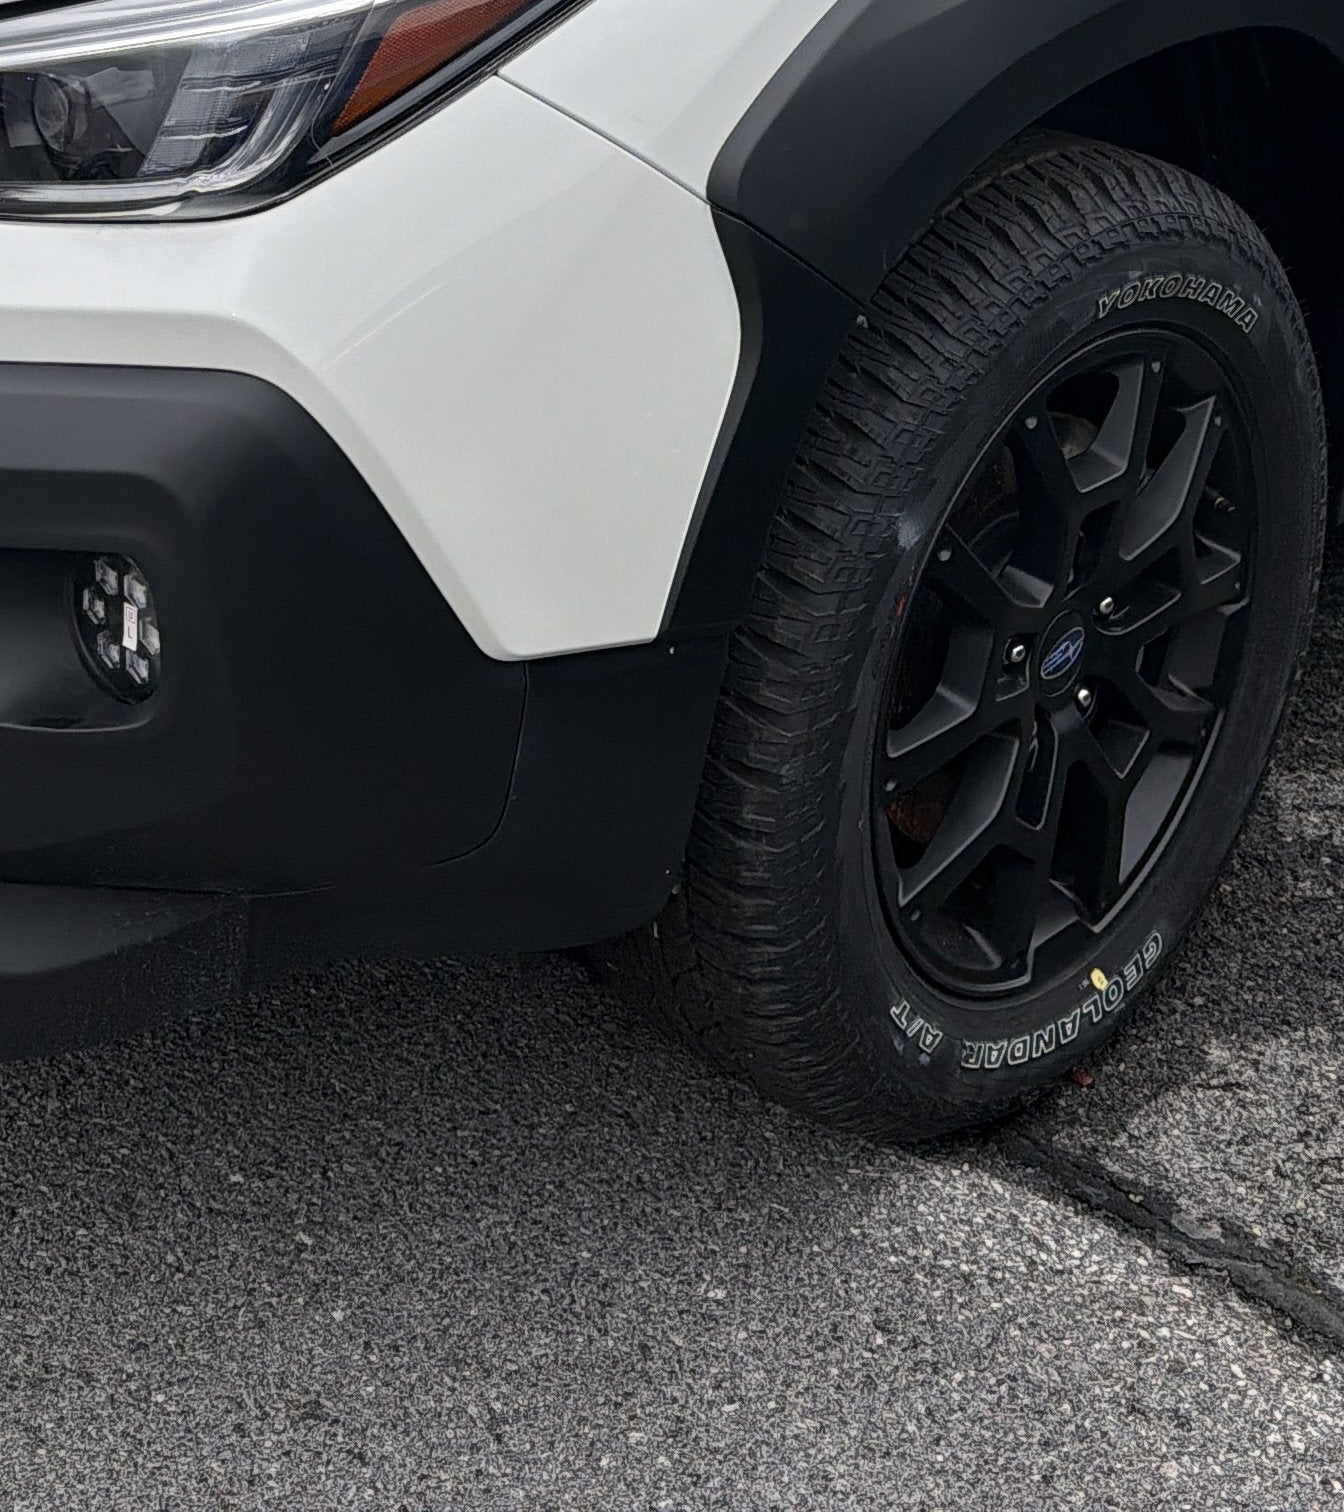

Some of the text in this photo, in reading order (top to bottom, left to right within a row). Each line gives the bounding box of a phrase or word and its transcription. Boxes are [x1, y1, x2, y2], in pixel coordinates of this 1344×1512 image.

[1098, 273, 1259, 334] YOKOHAMA
[890, 931, 1163, 1069] GEOLANDAR A/T
